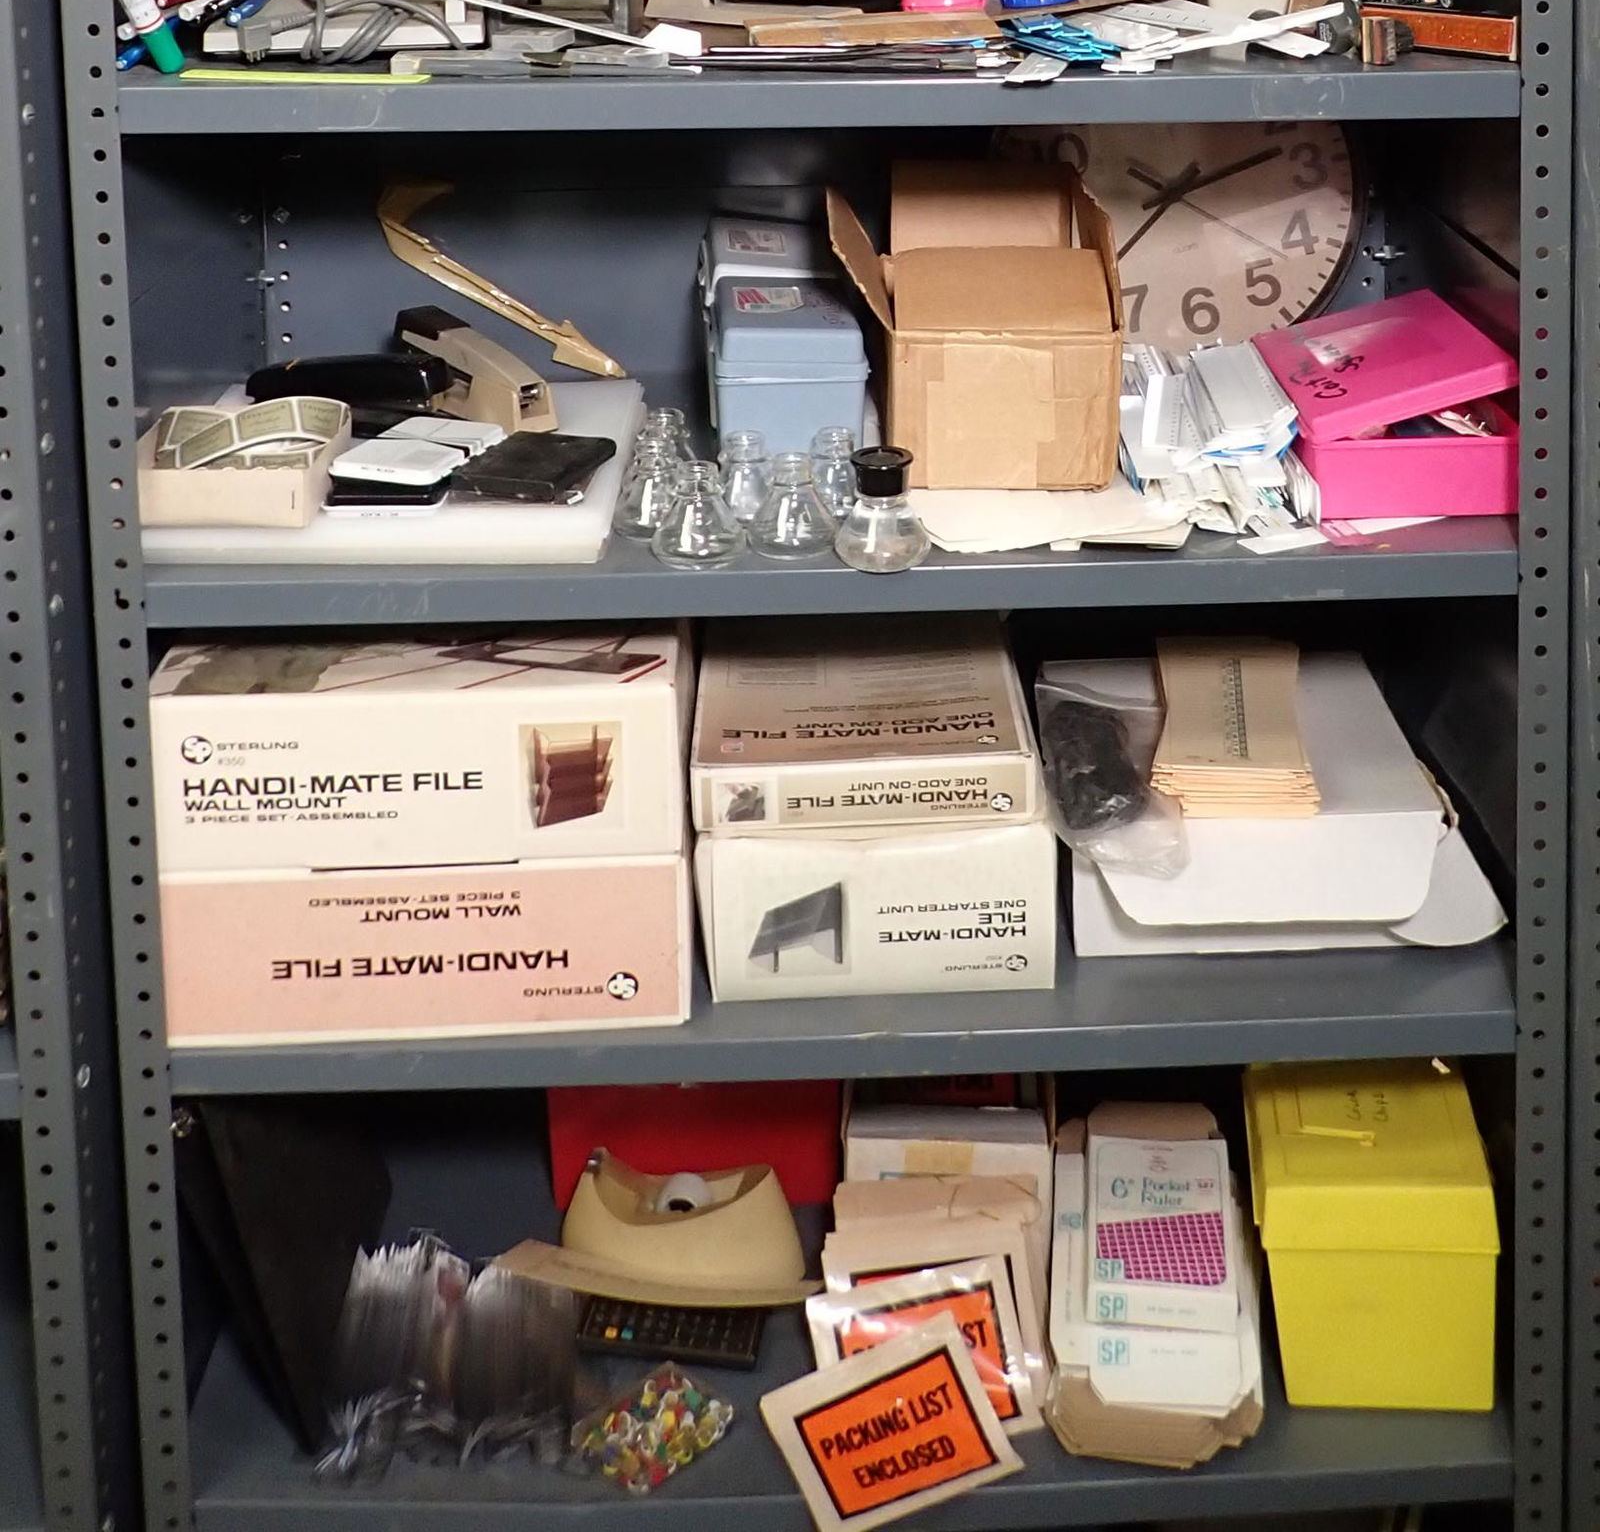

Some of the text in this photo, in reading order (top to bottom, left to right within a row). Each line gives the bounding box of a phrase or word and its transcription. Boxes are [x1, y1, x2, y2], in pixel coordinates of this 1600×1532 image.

[1289, 141, 1328, 186] 3
[1280, 207, 1319, 255] 4
[1245, 257, 1282, 307] 5
[1121, 284, 1149, 334] 7
[1181, 287, 1220, 335] 6
[721, 719, 996, 740] HANDI-MATE FILE
[792, 711, 993, 730] ONE ADD-ON UNIT
[216, 740, 299, 751] STERLING
[183, 771, 483, 797] HANDI-MATE FILE
[847, 777, 988, 792] ONE ADD-ON UNIT
[184, 796, 347, 812] WALL MOUNT
[787, 789, 988, 809] HANDI-MATE FILE
[931, 803, 988, 811] STERLING
[185, 815, 195, 824] 3
[202, 814, 250, 823] PIECE
[456, 892, 504, 901] PIECE
[510, 890, 520, 899] 3
[359, 904, 521, 923] WALL MOUNT
[876, 898, 1027, 914] ONE STARTER UNIT
[978, 911, 1026, 924] FILE
[878, 925, 1027, 943] HANDI-MATE
[271, 949, 569, 980] HANDI-MATE FILE
[944, 963, 1003, 972] STERLING
[522, 985, 604, 997] STERLING
[1142, 1176, 1190, 1192] Pocket
[1140, 1190, 1184, 1206] Ruler
[1096, 1259, 1123, 1281] SP
[1098, 1294, 1125, 1320] SP
[957, 1318, 987, 1349] ST
[1101, 1338, 1126, 1365] SP
[819, 1382, 954, 1460] PACKING LIST
[852, 1434, 957, 1489] ENCLOSED
